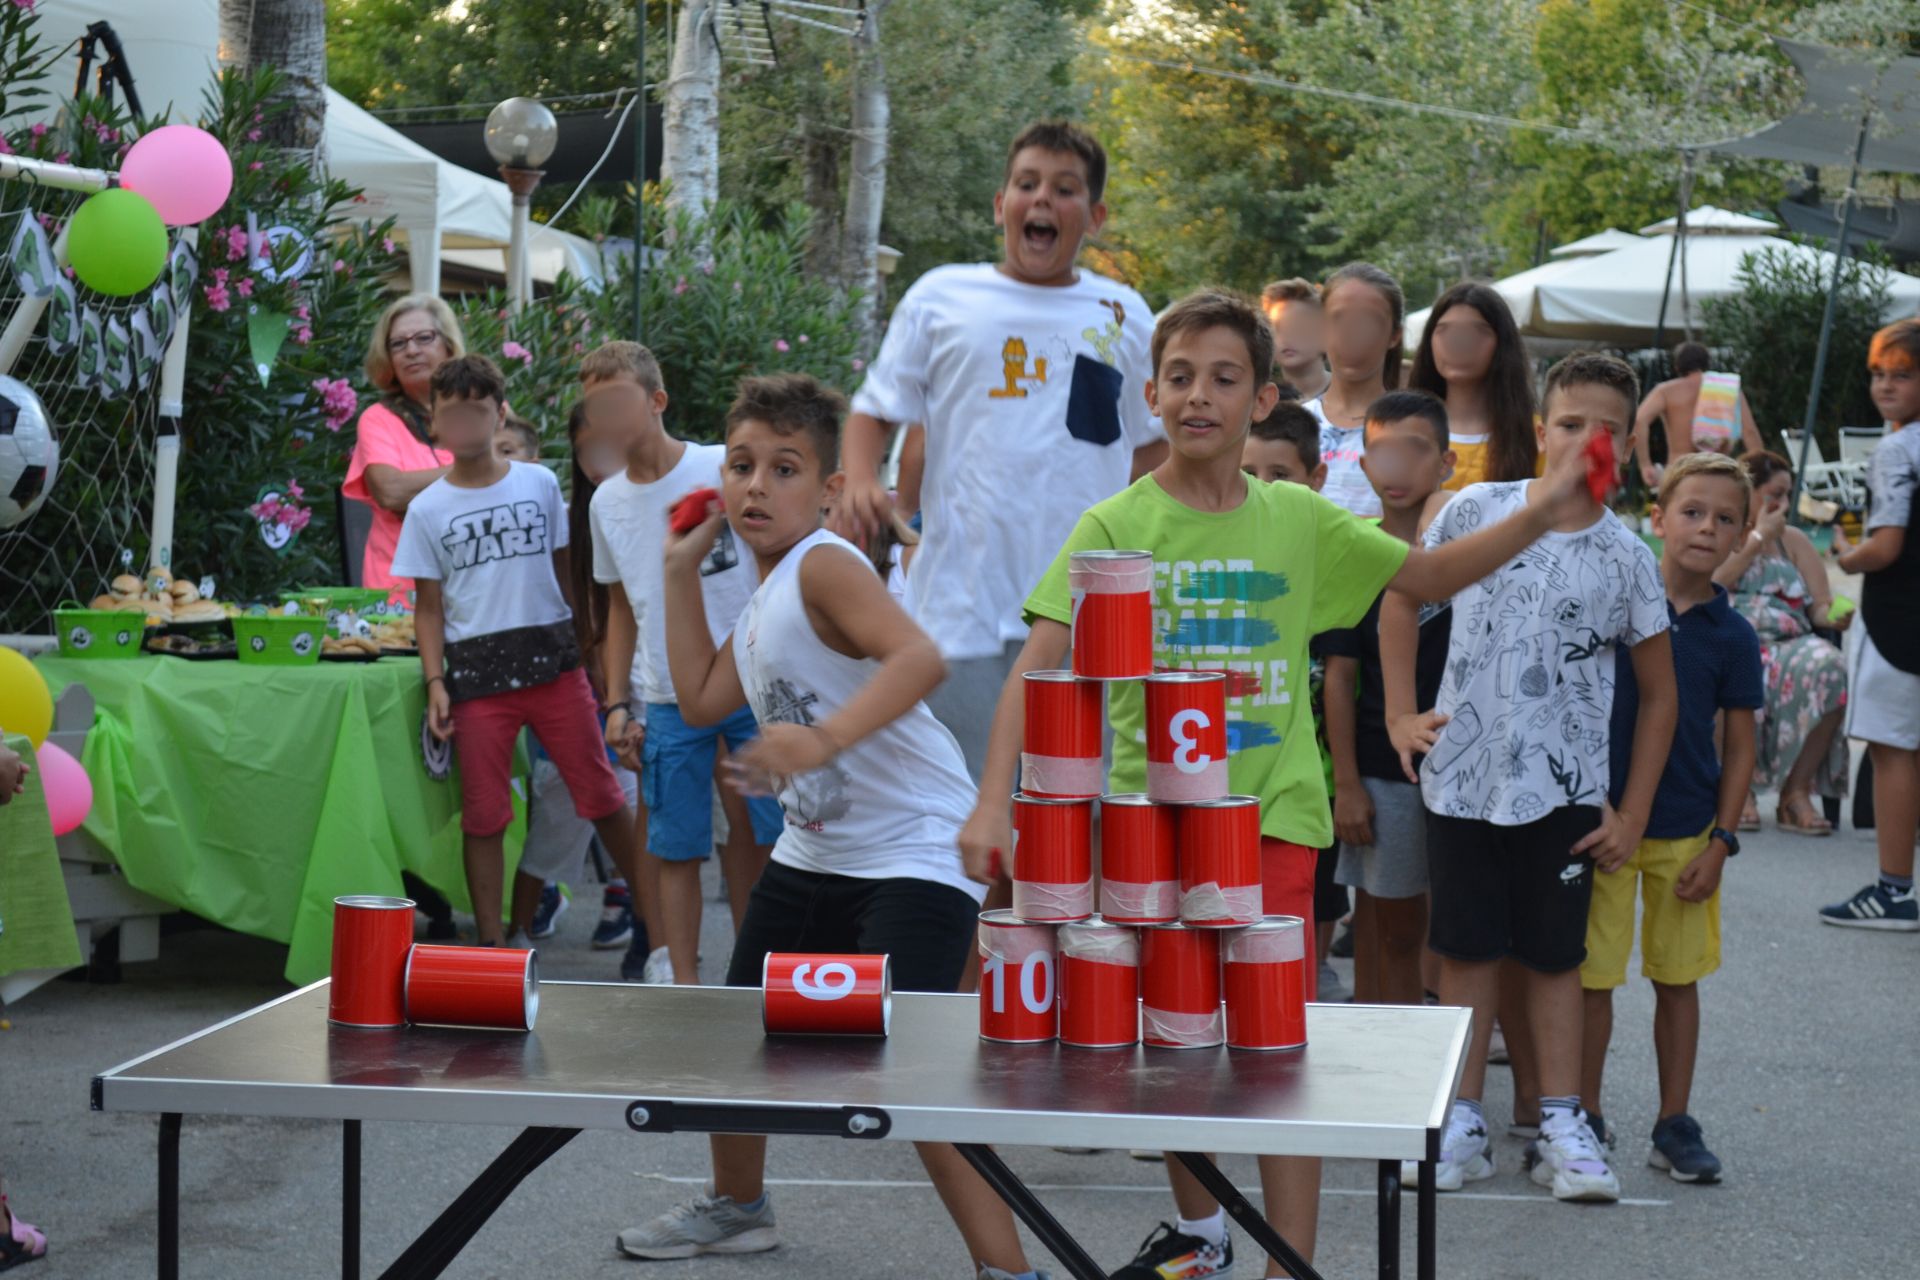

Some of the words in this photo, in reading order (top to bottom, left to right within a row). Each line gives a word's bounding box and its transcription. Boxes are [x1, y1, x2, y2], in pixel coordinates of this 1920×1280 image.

[441, 500, 546, 547] STAR
[444, 526, 546, 571] WARS
[1150, 559, 1254, 606] FOOT
[1152, 608, 1252, 655] BALL
[1169, 708, 1211, 774] 3
[983, 949, 1055, 1014] 10
